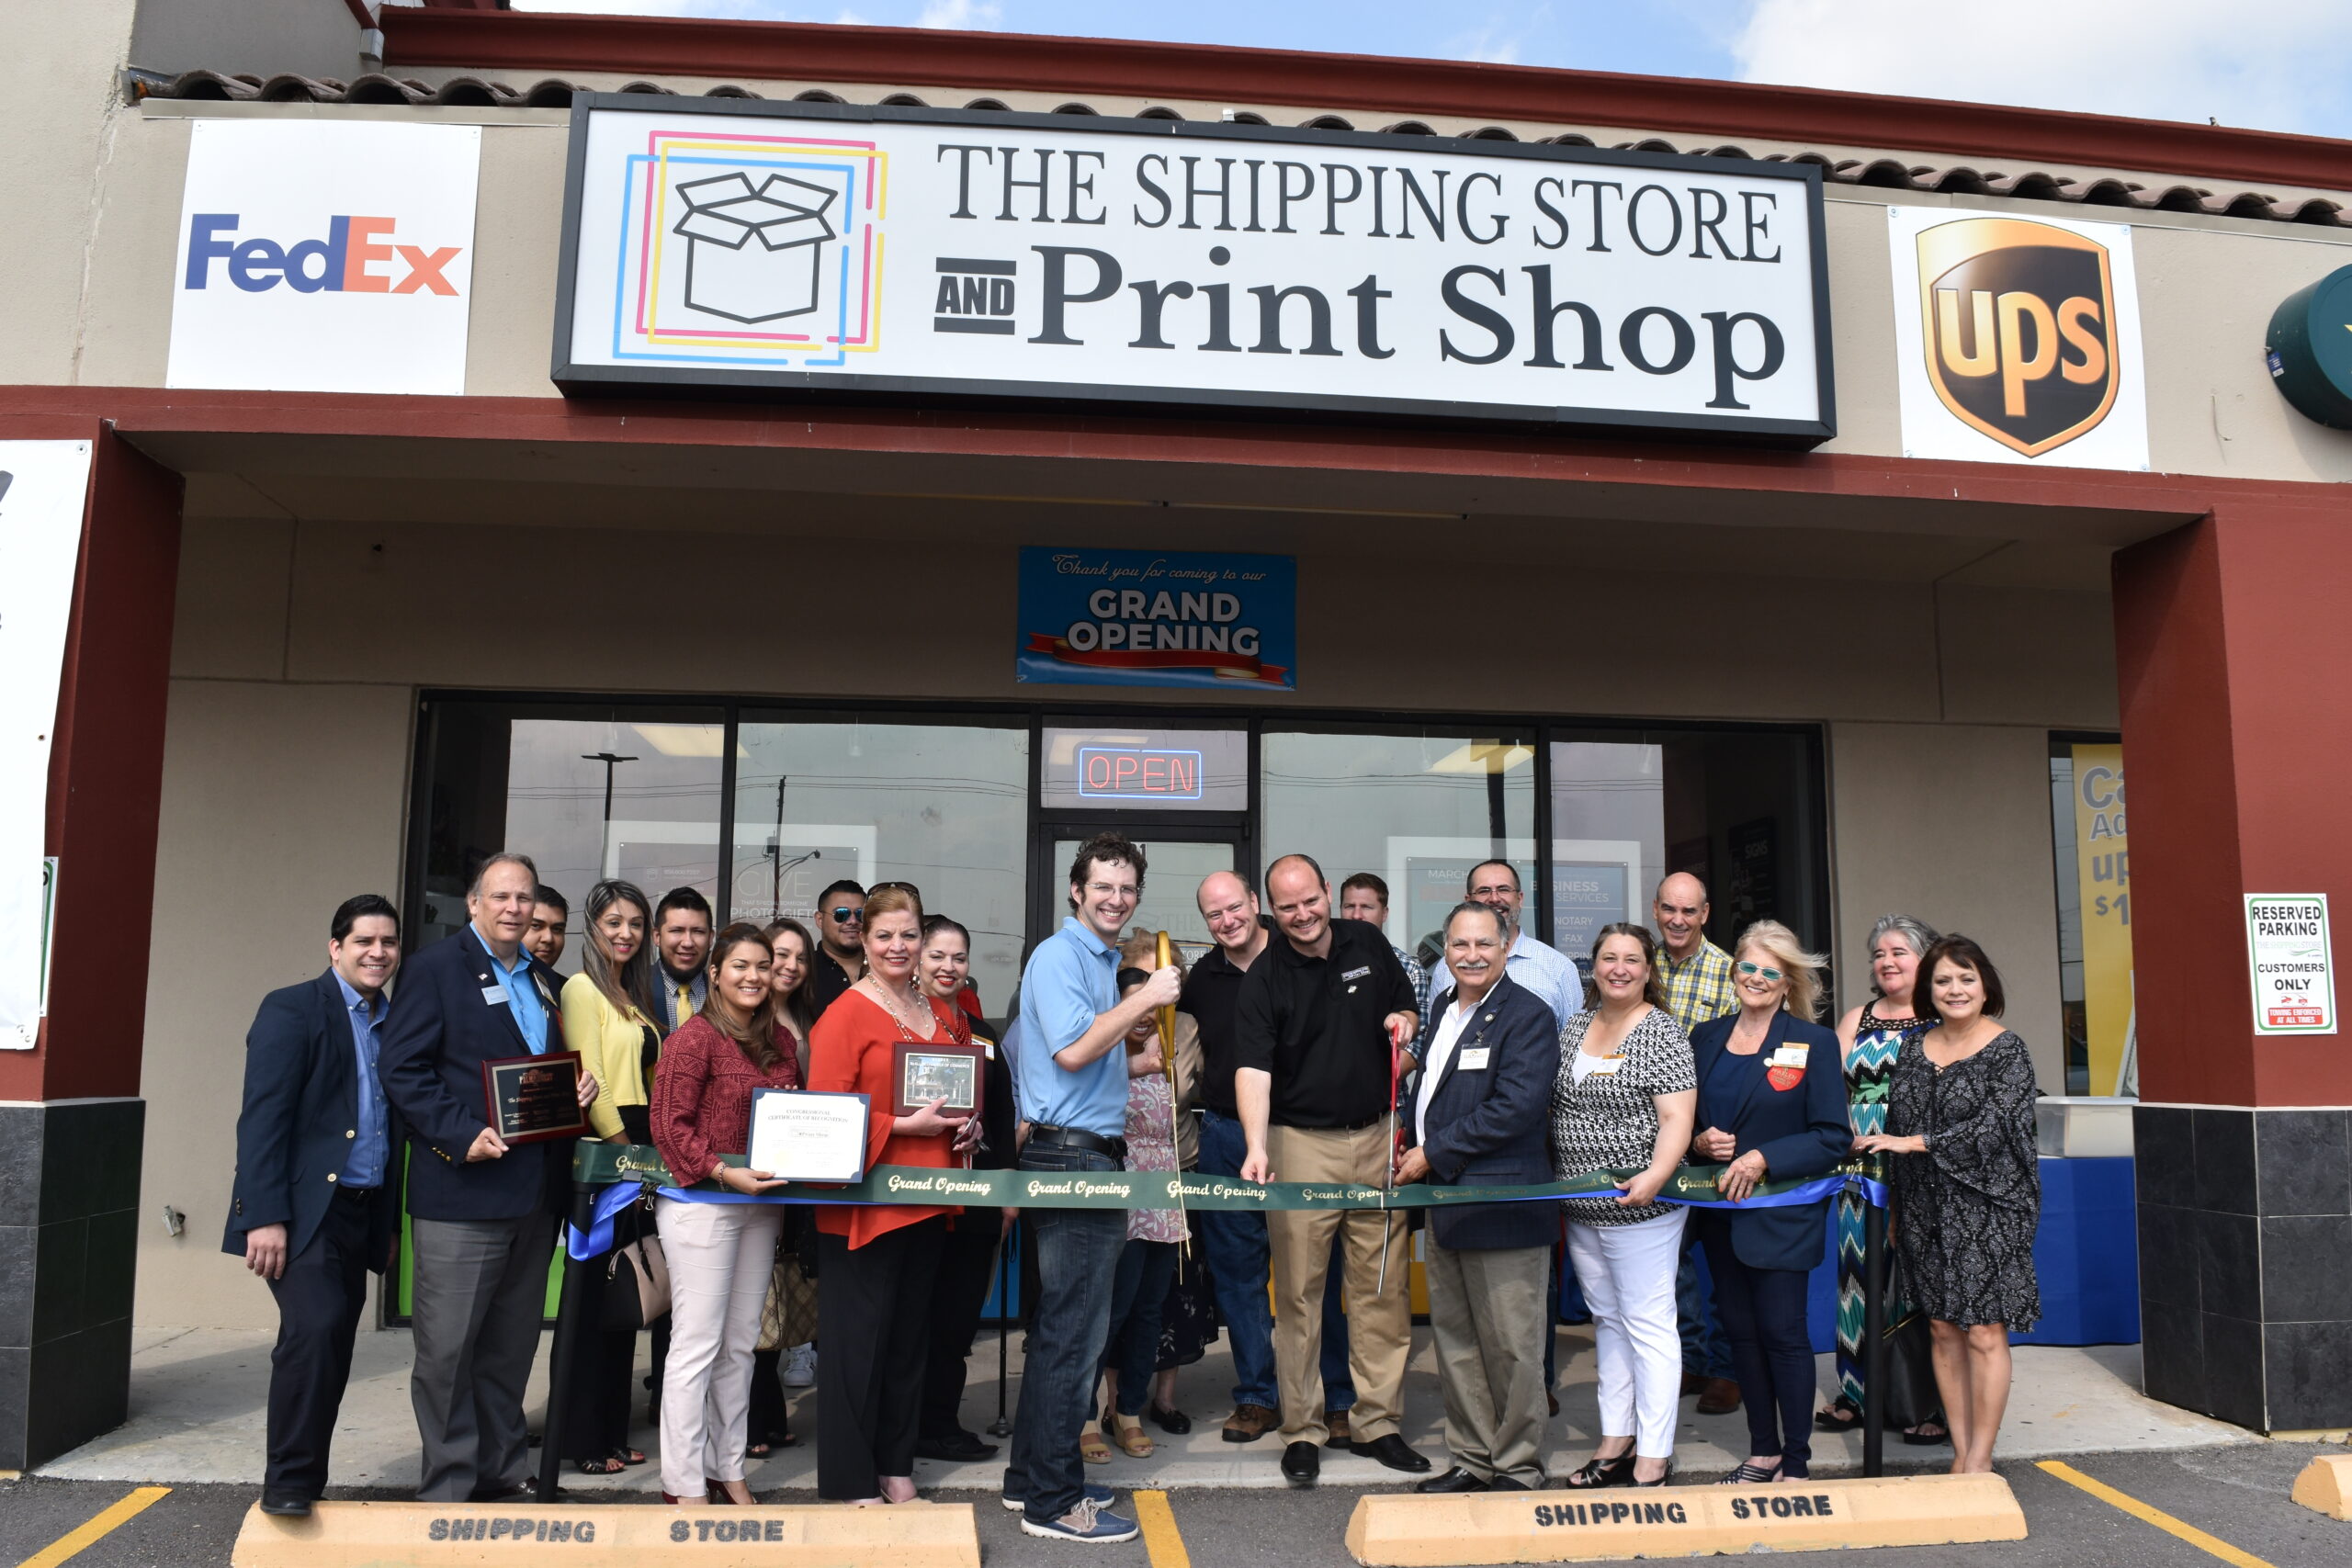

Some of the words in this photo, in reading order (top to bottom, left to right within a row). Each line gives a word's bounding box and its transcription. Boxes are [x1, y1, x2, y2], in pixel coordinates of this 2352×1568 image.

[938, 144, 1107, 225] THE
[1135, 153, 1510, 245] SHIPPING
[1532, 176, 1781, 264] STORE
[185, 213, 463, 297] FedEx
[935, 276, 1015, 316] AND
[1027, 245, 1396, 360] Print
[1439, 265, 1785, 411] Shop
[1052, 554, 1108, 575] Thank
[1109, 566, 1139, 581] you
[1140, 558, 1167, 582] for
[1169, 569, 1218, 584] coming
[1222, 569, 1238, 580] to
[1241, 571, 1267, 581] our
[1089, 589, 1241, 622] GRAND
[1068, 622, 1260, 657] OPENING
[1088, 756, 1193, 792] OPEN
[1556, 892, 1610, 902] SERVICES
[1555, 917, 1594, 927] NOTARY
[2252, 906, 2322, 920] RESERVED
[2258, 922, 2317, 936] PARKING
[2257, 963, 2325, 973] CUSTOMERS
[2274, 978, 2312, 991] ONLY
[616, 1155, 657, 1173] Grand
[888, 1175, 932, 1192] Grand
[935, 1176, 991, 1196] Opening
[1027, 1179, 1071, 1198] Grand
[1074, 1180, 1130, 1199] Opening
[1167, 1179, 1210, 1198] Grand
[1213, 1182, 1267, 1201] Opening
[1677, 1176, 1716, 1192] Grand
[1303, 1189, 1344, 1201] Grand
[1535, 1503, 1687, 1527] SHIPPING
[1731, 1495, 1833, 1519] STORE
[429, 1517, 595, 1543] SHIPPING
[670, 1519, 785, 1542] STORE
